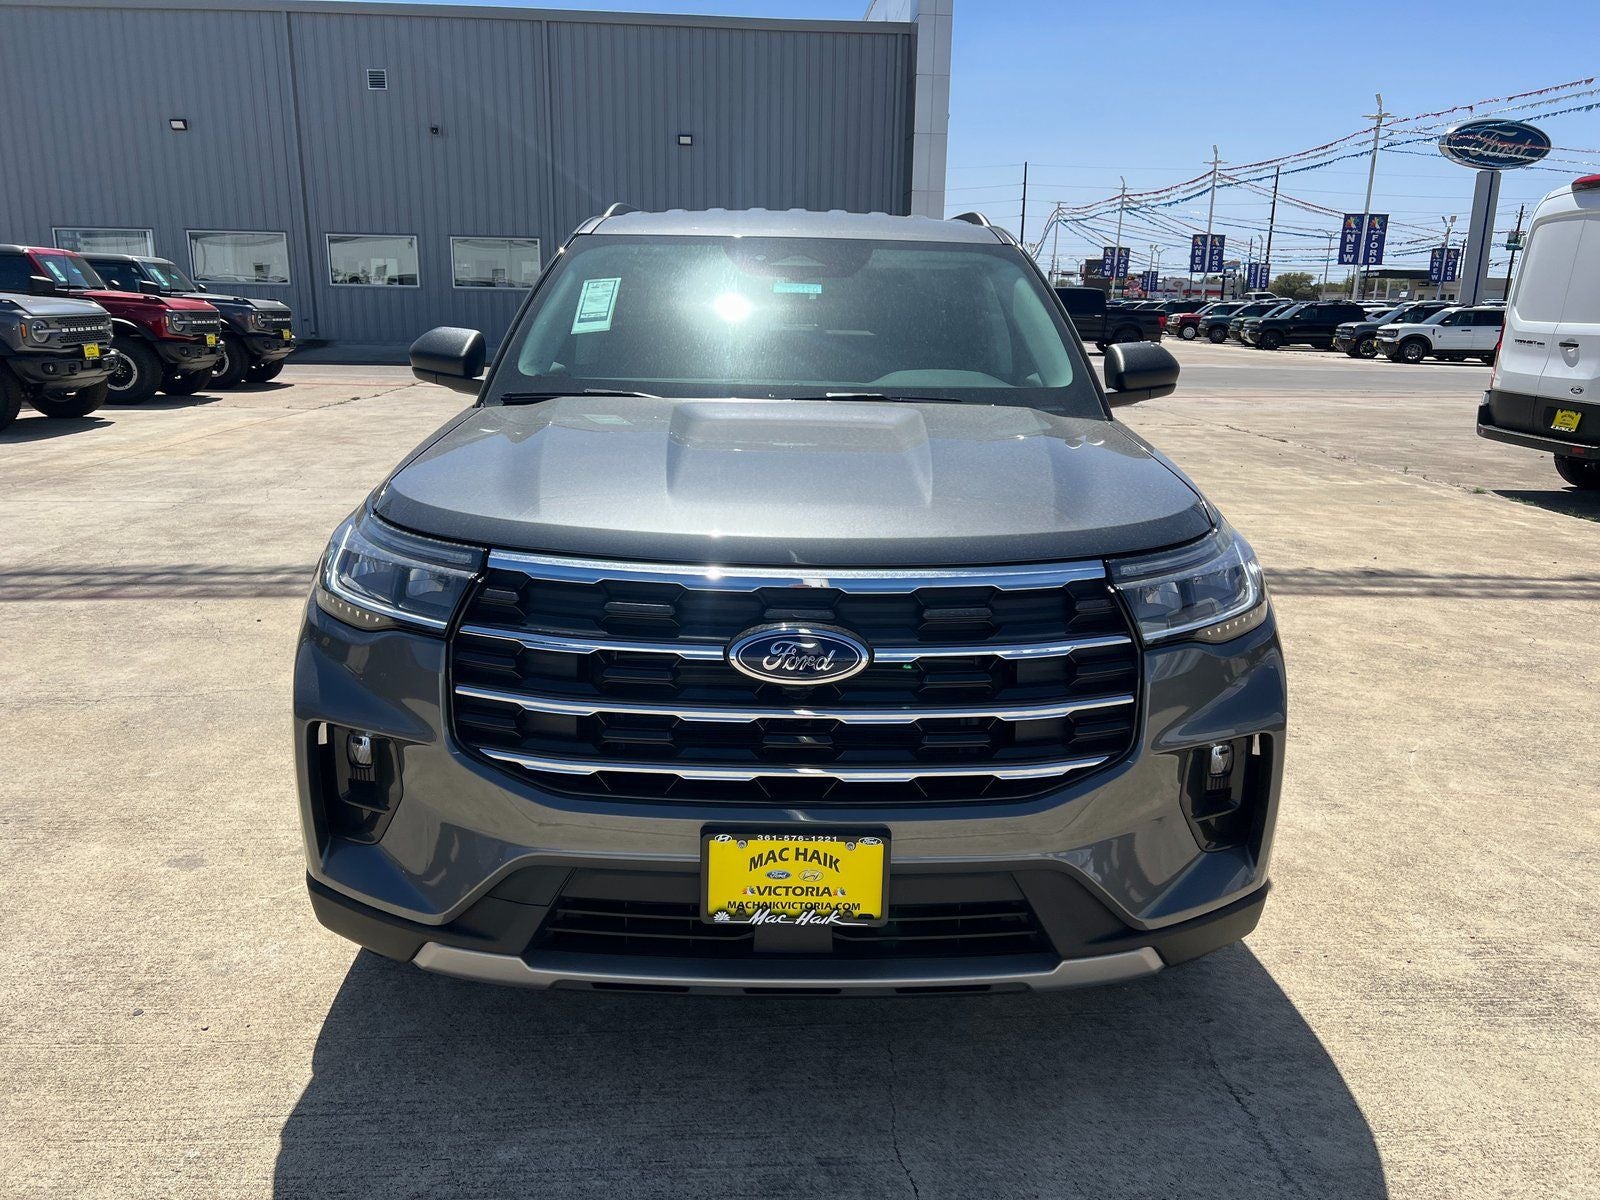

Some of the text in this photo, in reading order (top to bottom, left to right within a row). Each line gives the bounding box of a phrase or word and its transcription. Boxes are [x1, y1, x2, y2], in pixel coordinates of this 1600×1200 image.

[1468, 129, 1531, 157] Ford
[1343, 234, 1356, 263] NEW
[1368, 234, 1379, 263] FORD
[1193, 249, 1202, 271] NEW
[1431, 261, 1439, 280] NEW
[762, 640, 836, 671] Ford
[757, 834, 837, 842] 361-576-1221
[749, 847, 841, 874] MAC HAIK
[755, 885, 833, 897] VICTORIA
[727, 900, 861, 911] MACHAIKVICTORIA.COM
[748, 908, 842, 926] Mac Haik
